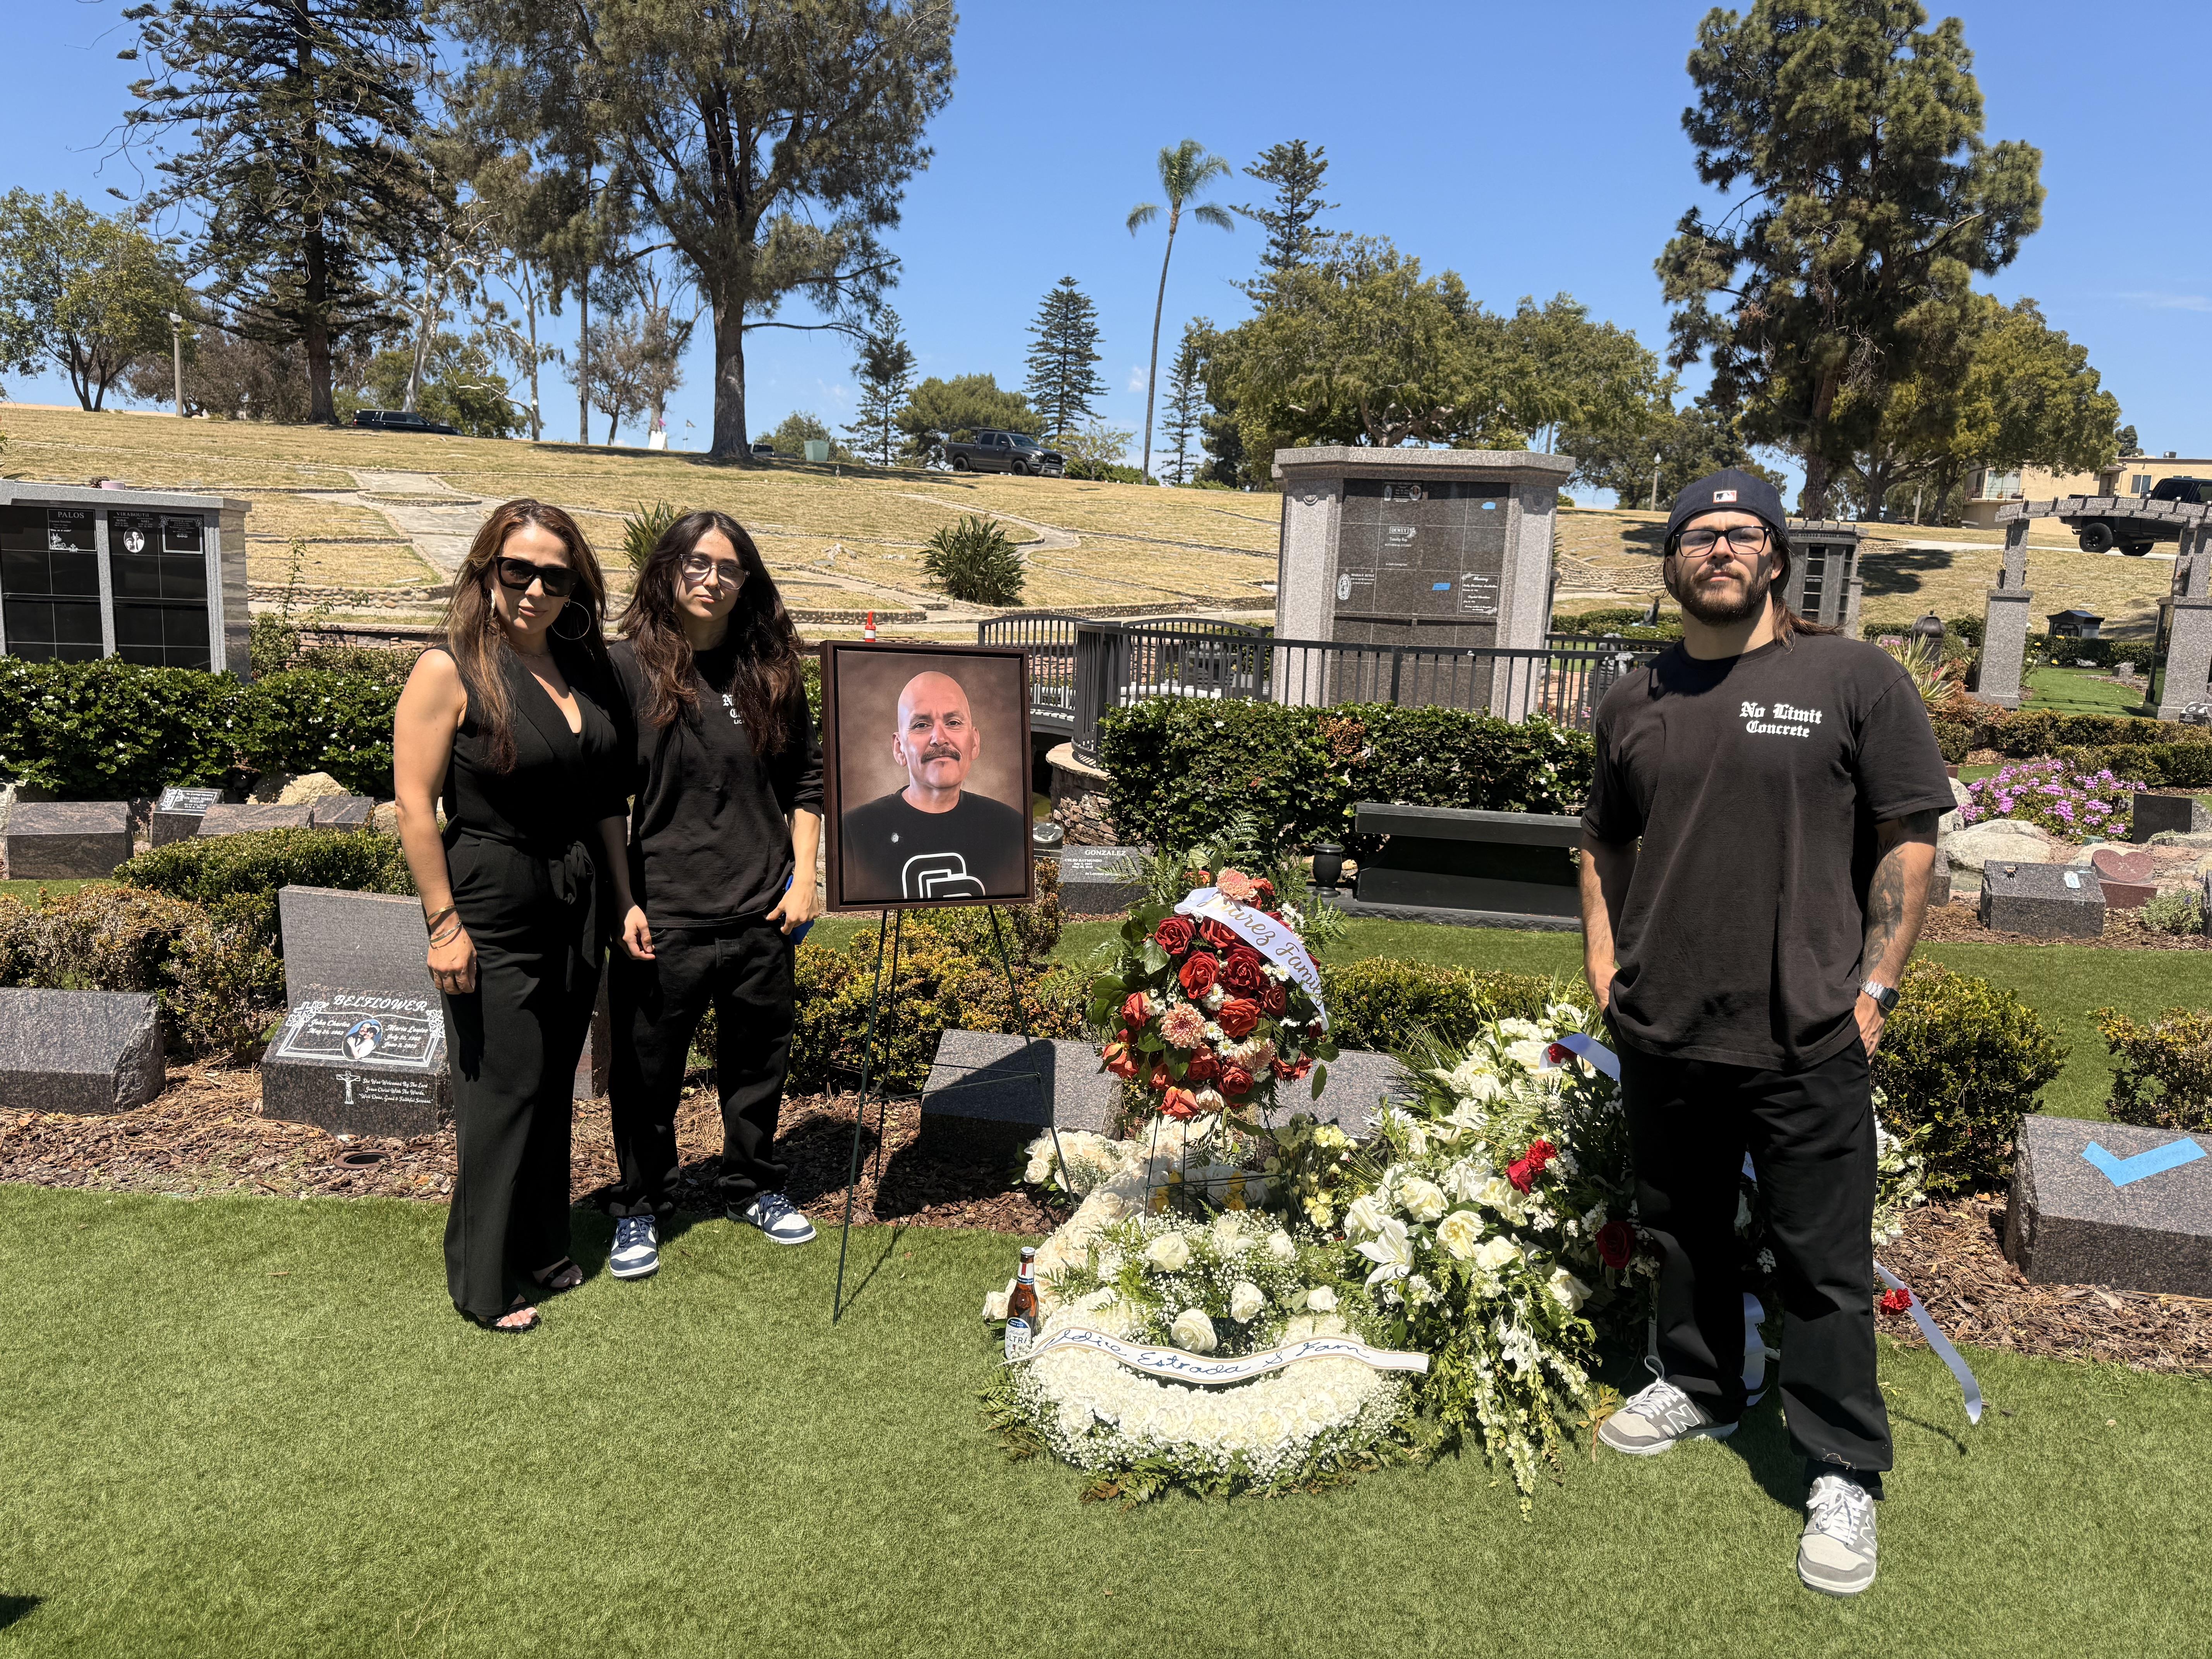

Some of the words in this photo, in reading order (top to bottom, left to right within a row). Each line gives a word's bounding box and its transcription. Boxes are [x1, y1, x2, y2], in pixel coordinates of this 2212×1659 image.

[1739, 701, 1766, 718] No
[1773, 703, 1822, 724] Limit
[1746, 720, 1810, 738] Concrete
[333, 994, 428, 1011] BELFLOWER
[308, 1019, 326, 1027] John
[1137, 1352, 1251, 1375] Estrada
